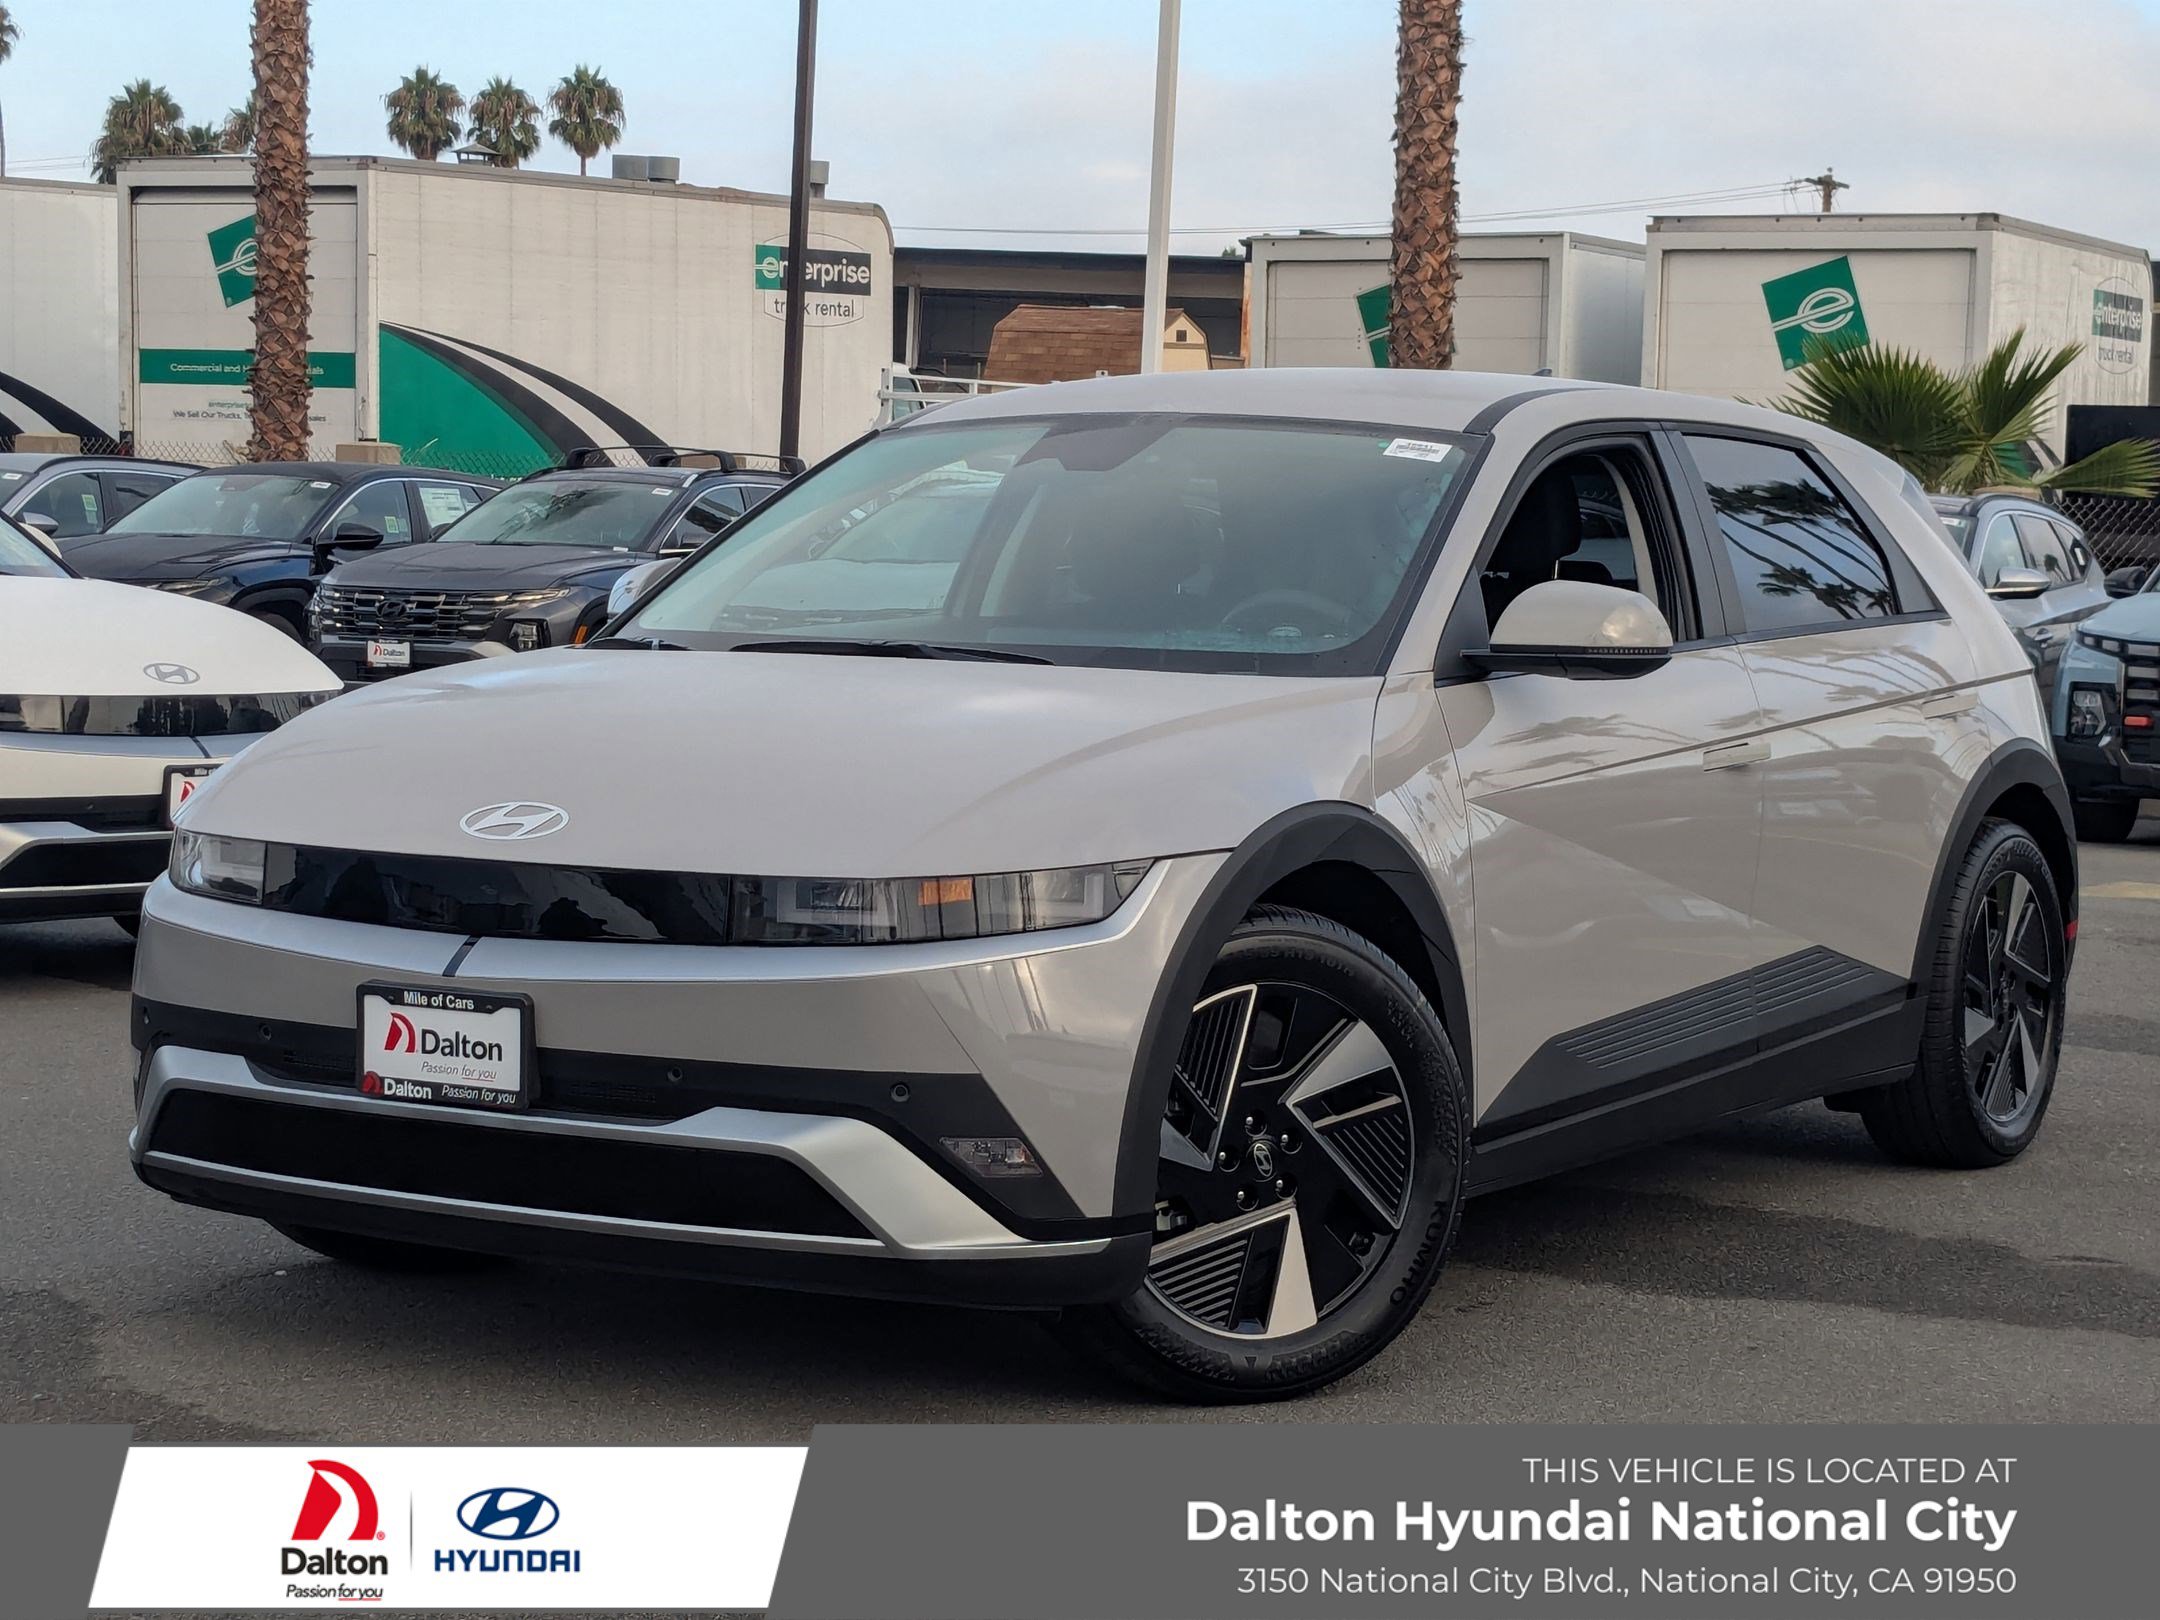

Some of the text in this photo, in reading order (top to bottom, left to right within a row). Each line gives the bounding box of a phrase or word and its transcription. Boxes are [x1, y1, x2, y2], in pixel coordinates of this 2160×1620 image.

[757, 256, 870, 288] enerprise
[774, 298, 854, 318] trk rental
[2094, 302, 2141, 331] enterprise
[170, 363, 222, 373] Commercial
[223, 364, 241, 373] and
[173, 410, 186, 418] We
[187, 410, 199, 418] Sell
[201, 411, 215, 419] Our
[404, 990, 475, 1010] Mile of Cars
[421, 1028, 503, 1062] Dalton
[421, 1061, 498, 1080] Passion for you
[384, 1078, 517, 1106] Dalton Passion for you
[1390, 1201, 1446, 1306] KUMHO
